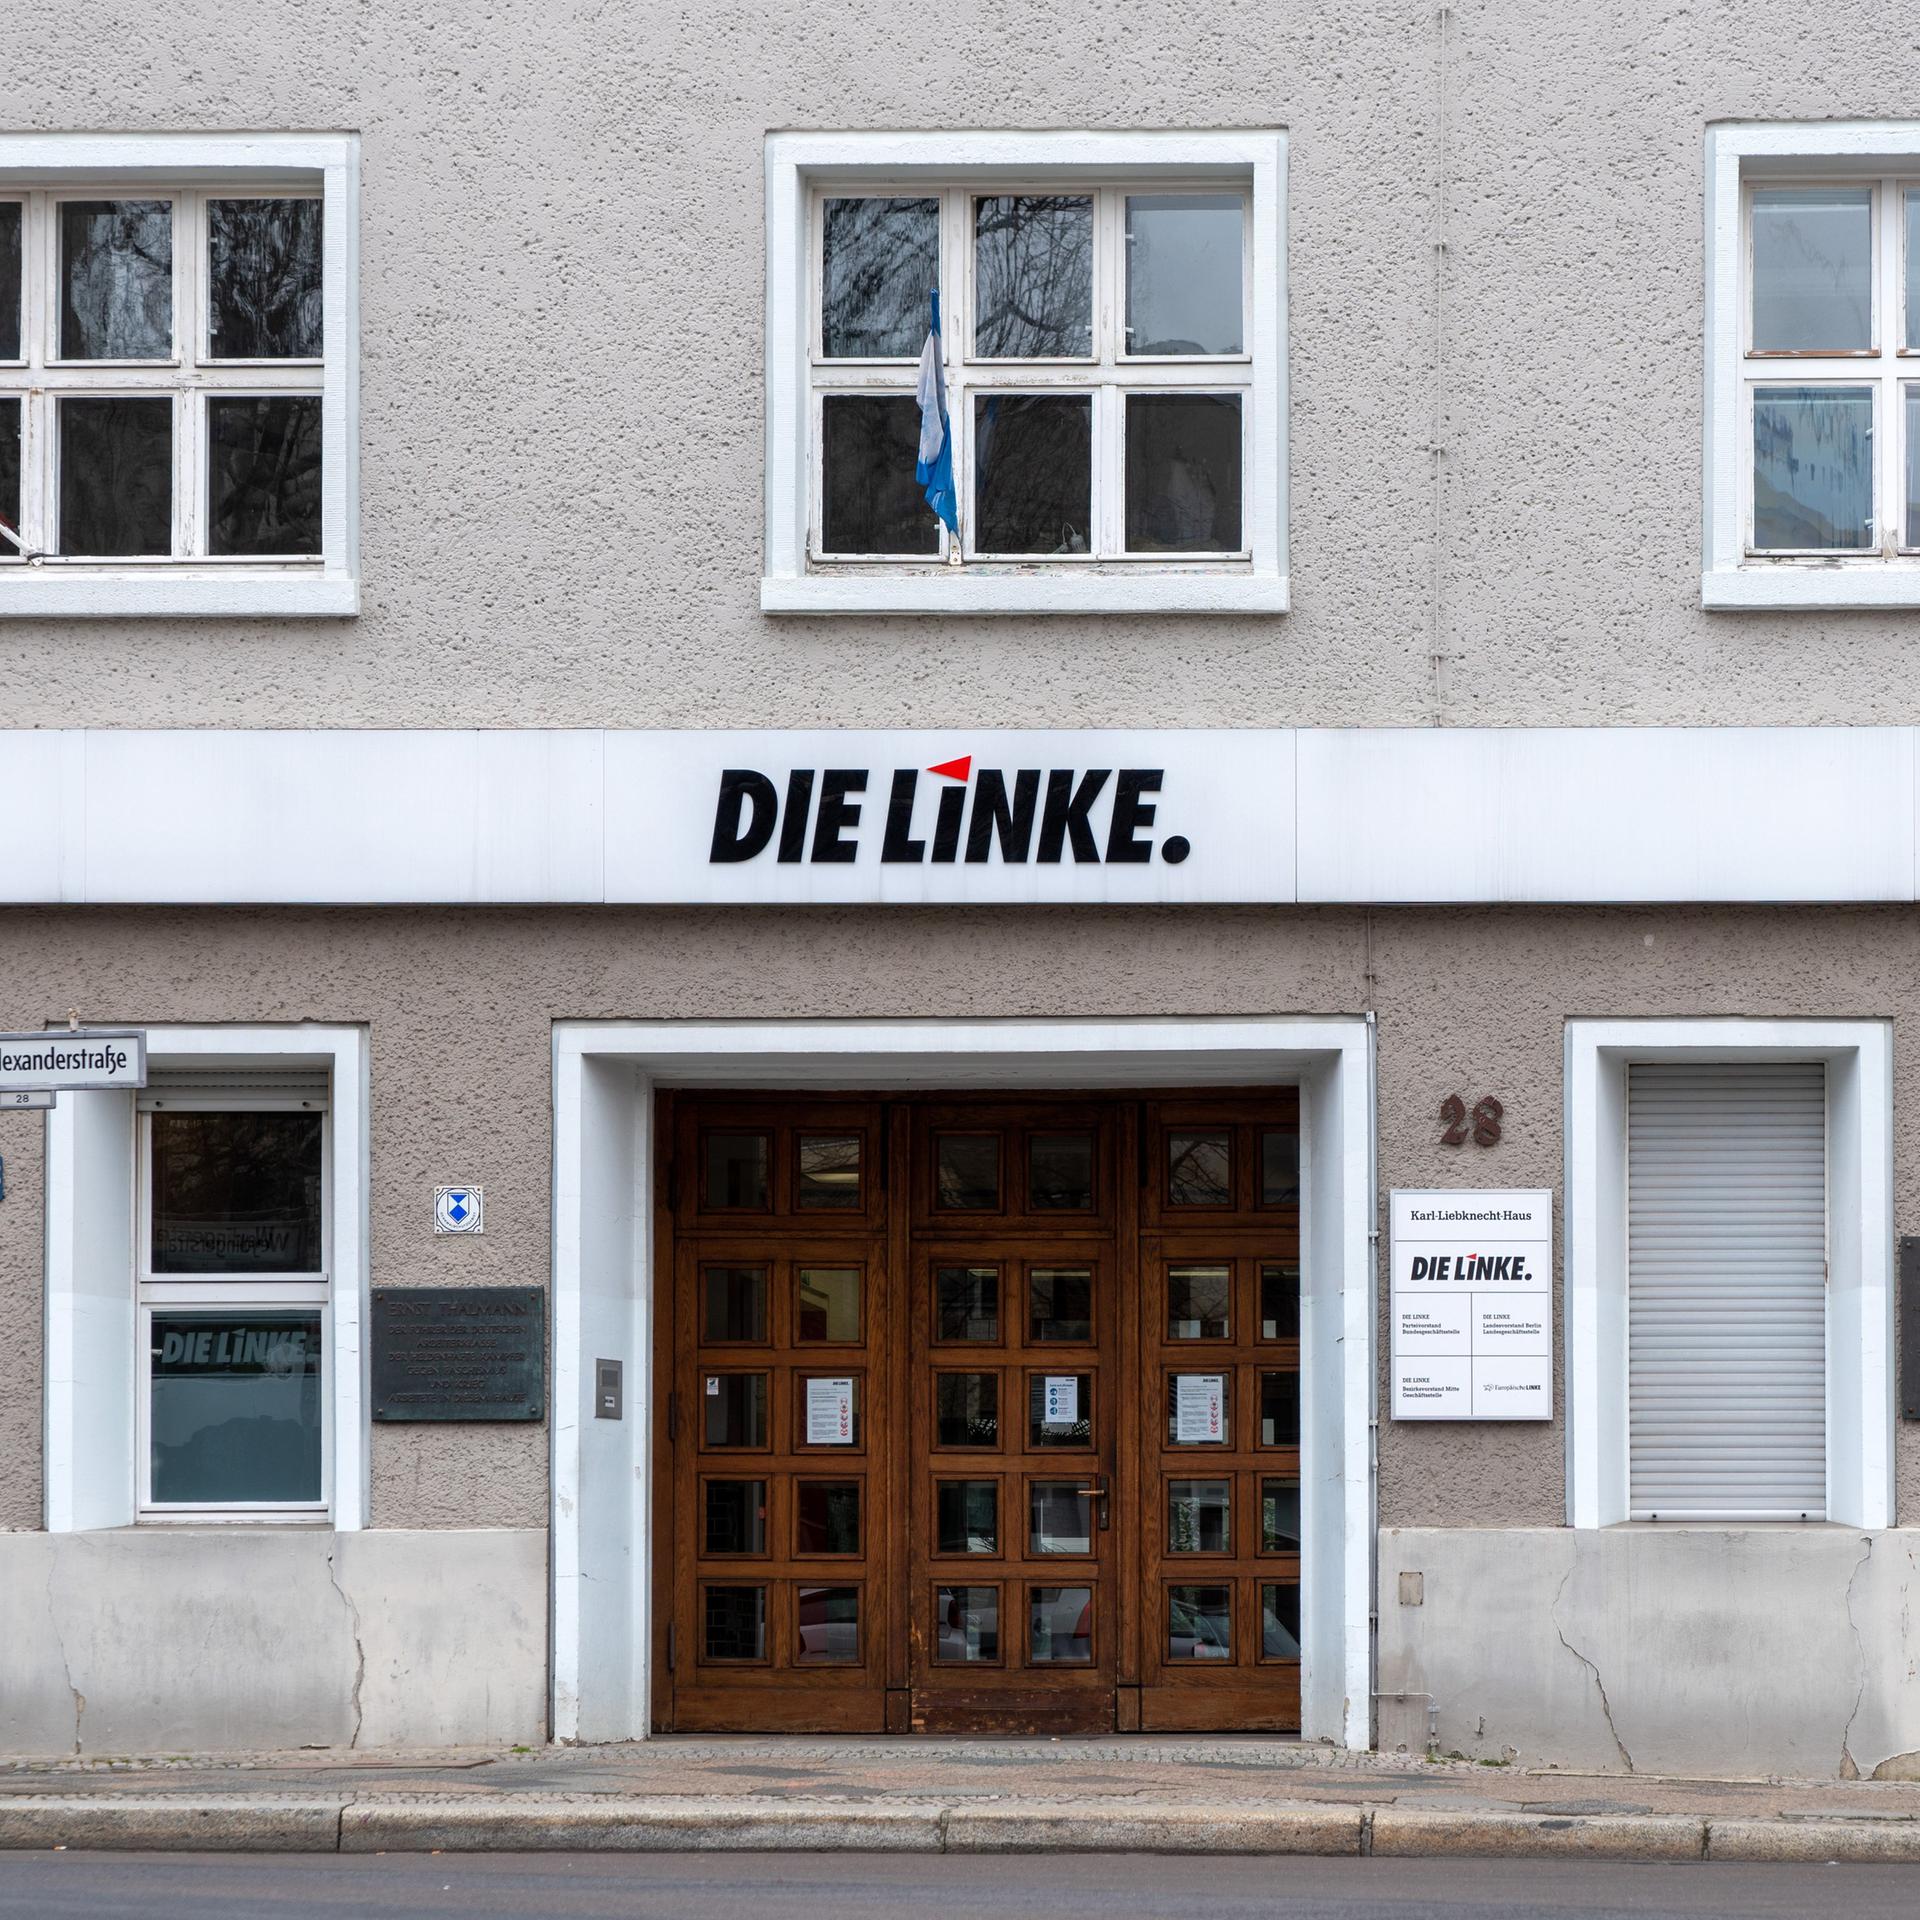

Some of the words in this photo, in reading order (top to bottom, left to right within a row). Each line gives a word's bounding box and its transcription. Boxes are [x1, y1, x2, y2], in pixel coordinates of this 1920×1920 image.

[709, 769, 869, 863] DIE
[16, 1094, 30, 1103] 28
[1440, 1093, 1504, 1146] 28
[1410, 1210, 1532, 1221] Karl-Liebknecht-Haus
[1410, 1256, 1451, 1280] DIE
[161, 1332, 213, 1363] DIE
